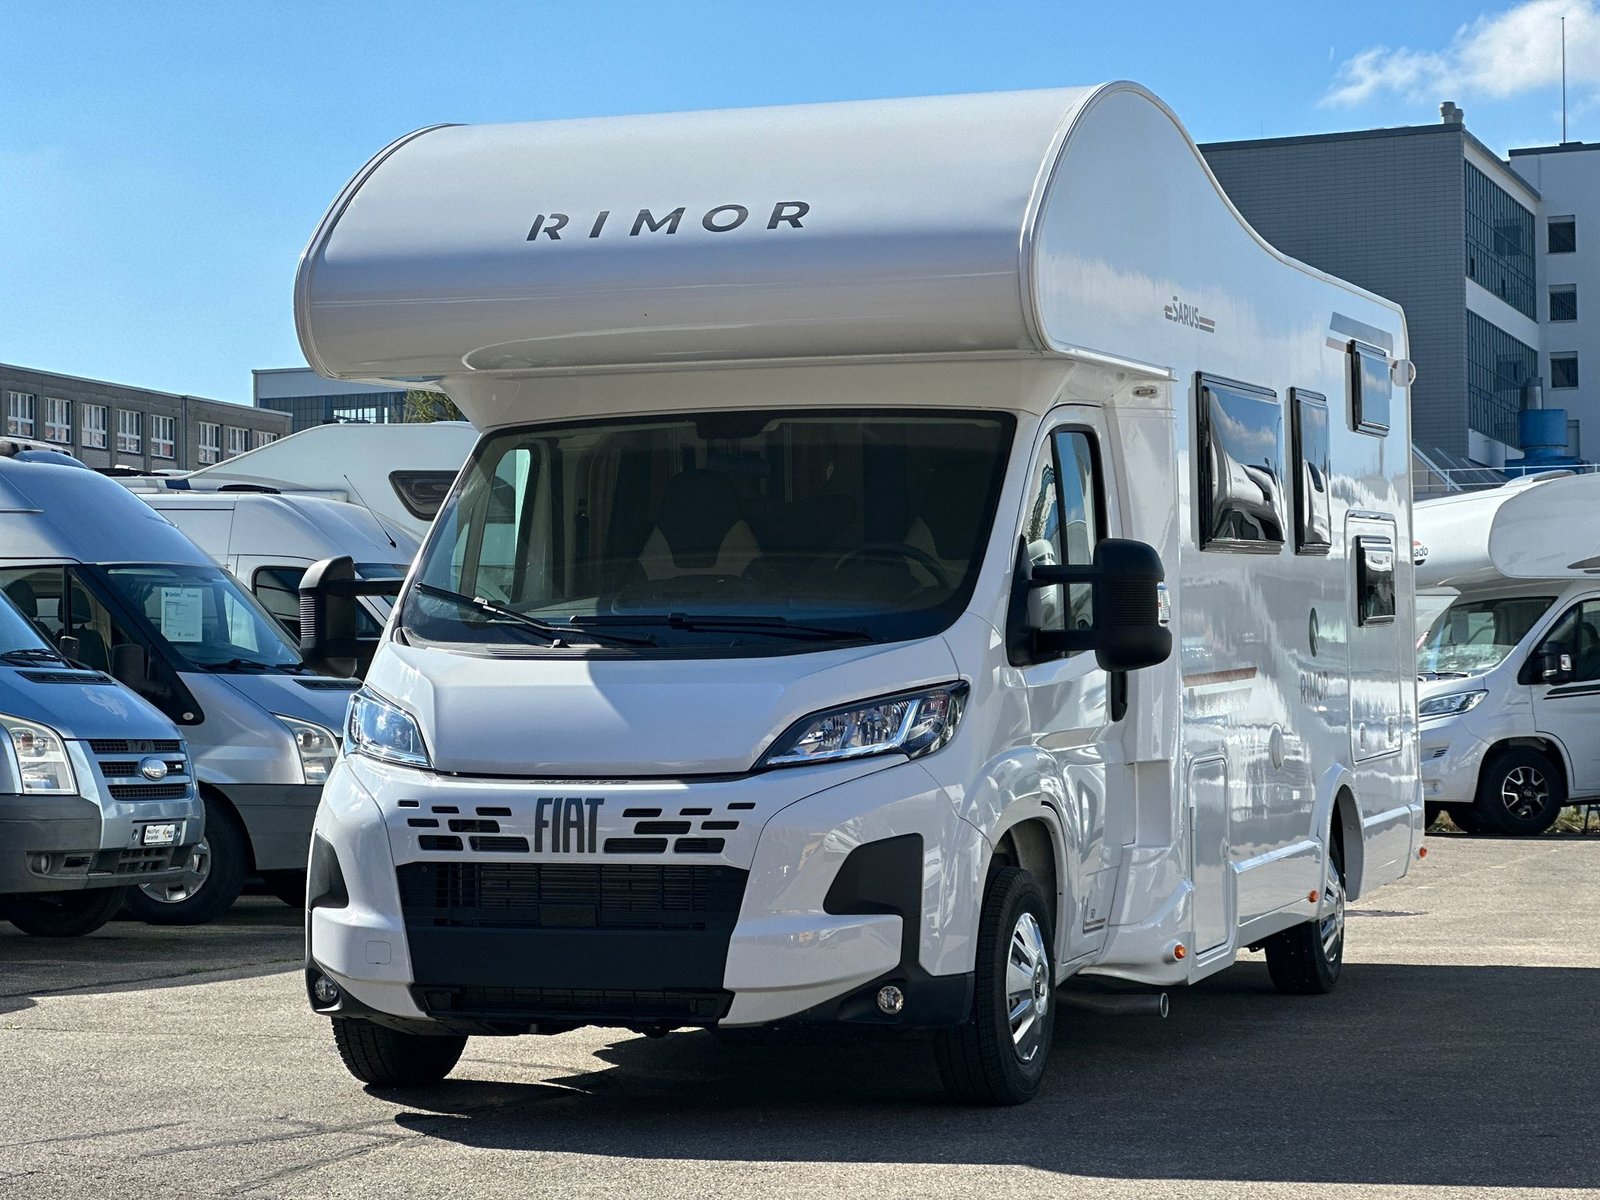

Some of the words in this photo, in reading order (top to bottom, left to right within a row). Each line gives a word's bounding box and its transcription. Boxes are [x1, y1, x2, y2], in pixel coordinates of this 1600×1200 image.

[526, 201, 810, 241] RIMOR
[1172, 299, 1199, 329] SARUS
[1413, 546, 1428, 557] ado
[1300, 671, 1328, 704] RIMOR
[534, 797, 604, 853] FIAT
